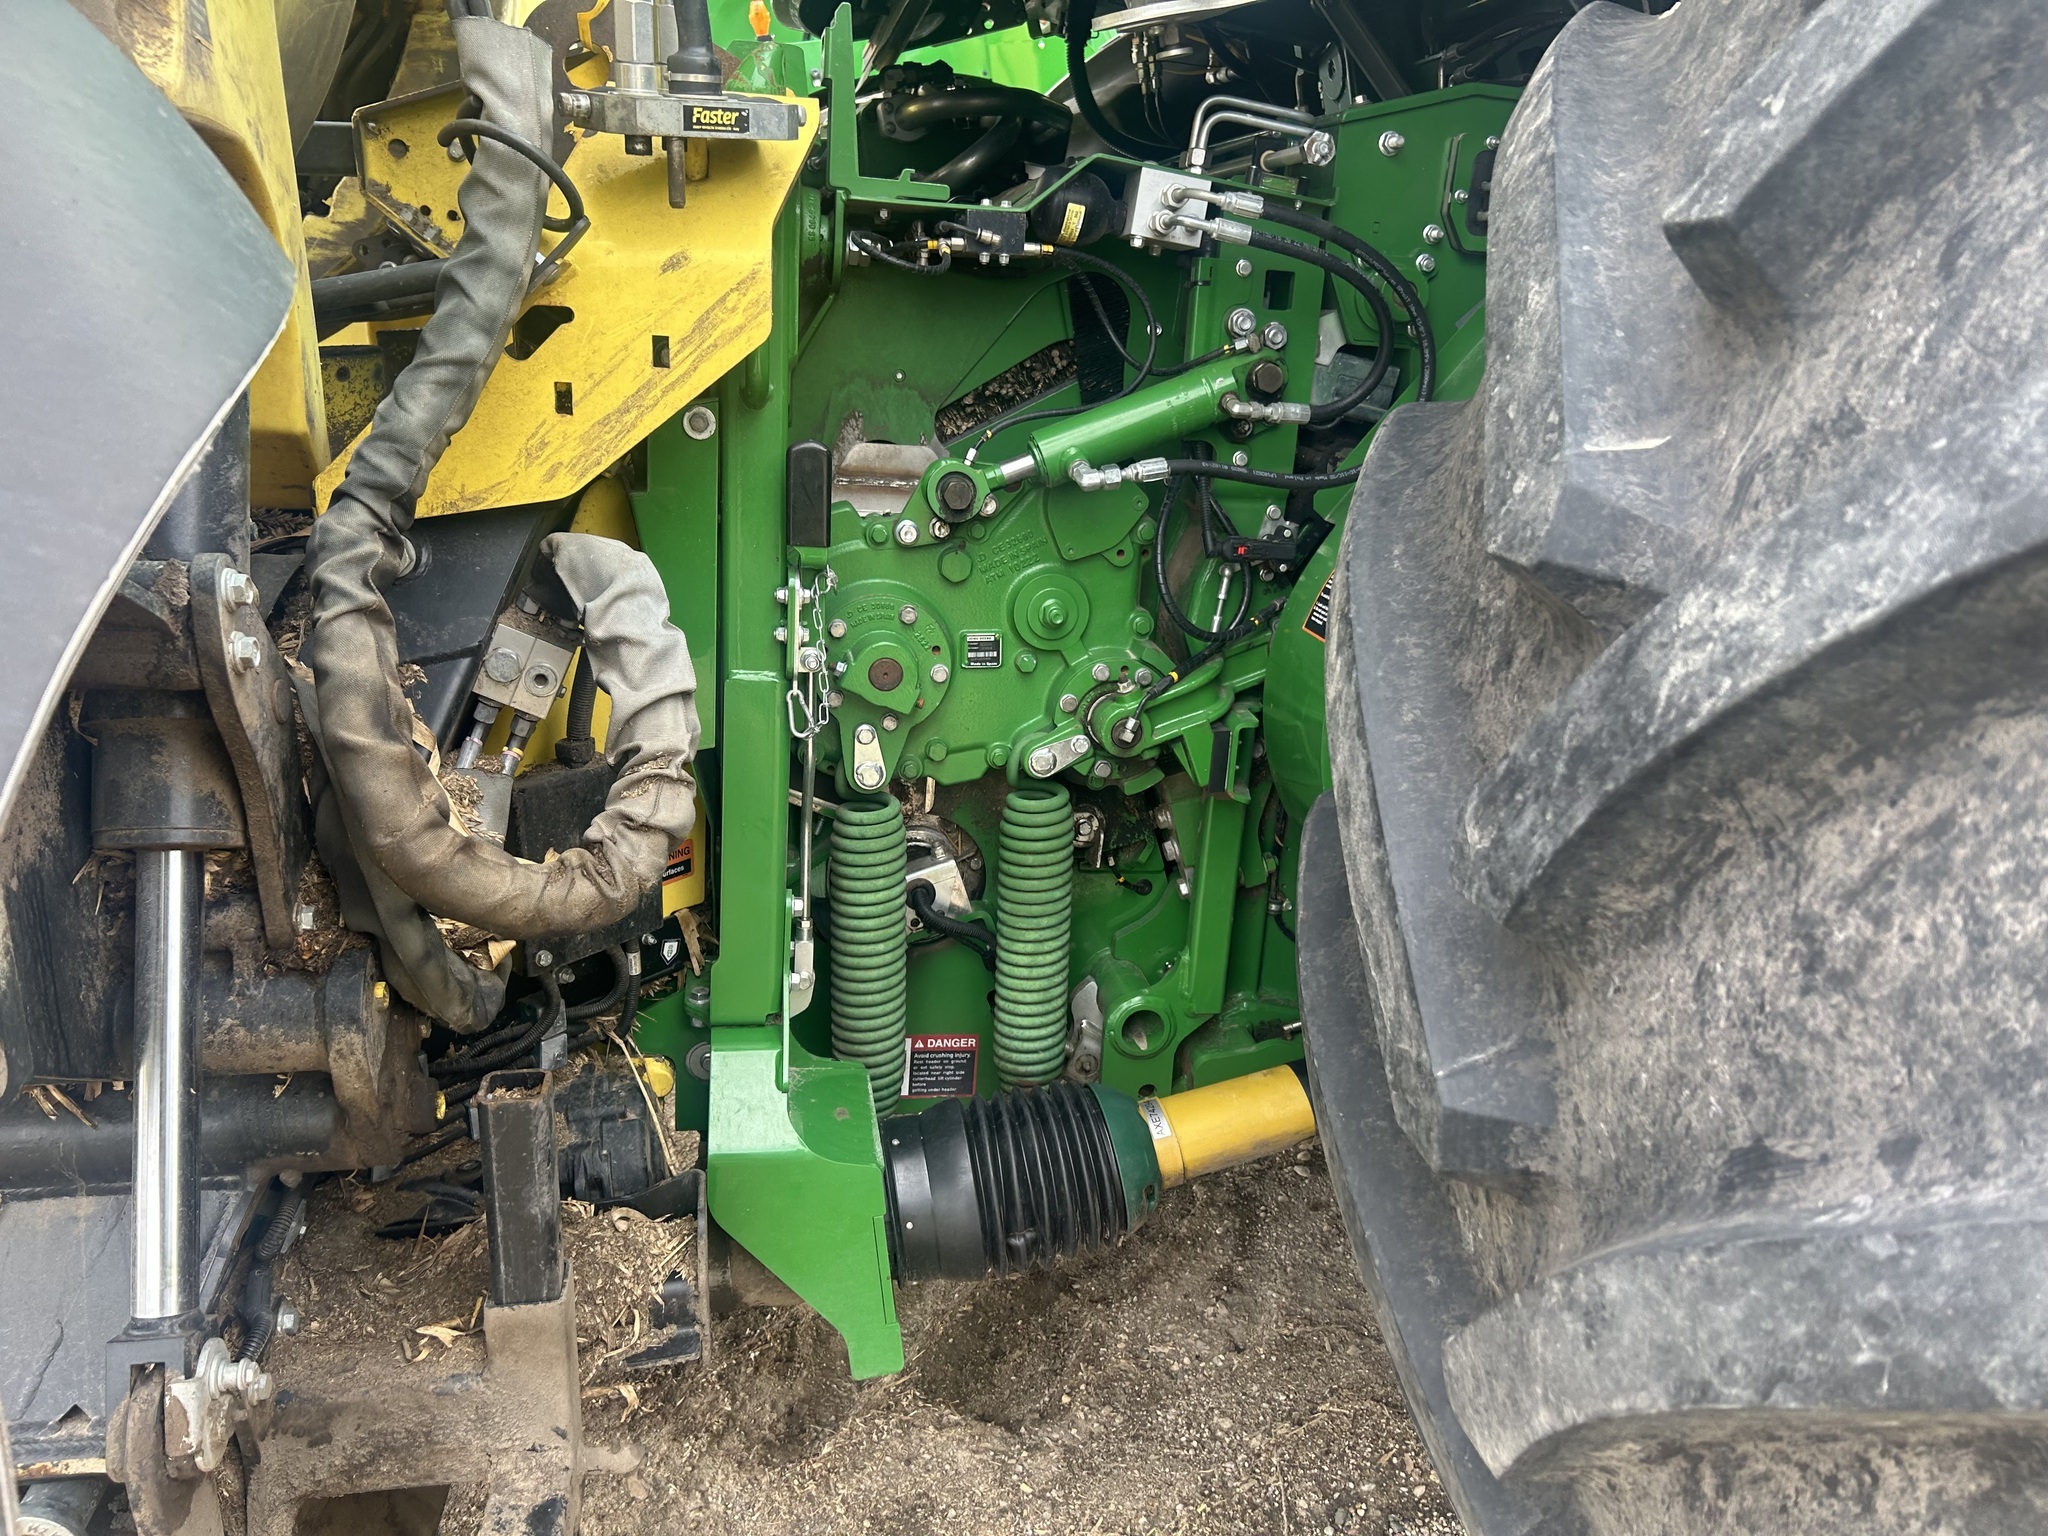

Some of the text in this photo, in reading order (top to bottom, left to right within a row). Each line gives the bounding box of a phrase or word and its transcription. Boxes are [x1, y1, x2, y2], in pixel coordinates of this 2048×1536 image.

[692, 107, 740, 125] Faster
[668, 846, 690, 861] NING
[662, 866, 684, 877] urfaces
[927, 1038, 976, 1047] DANGER
